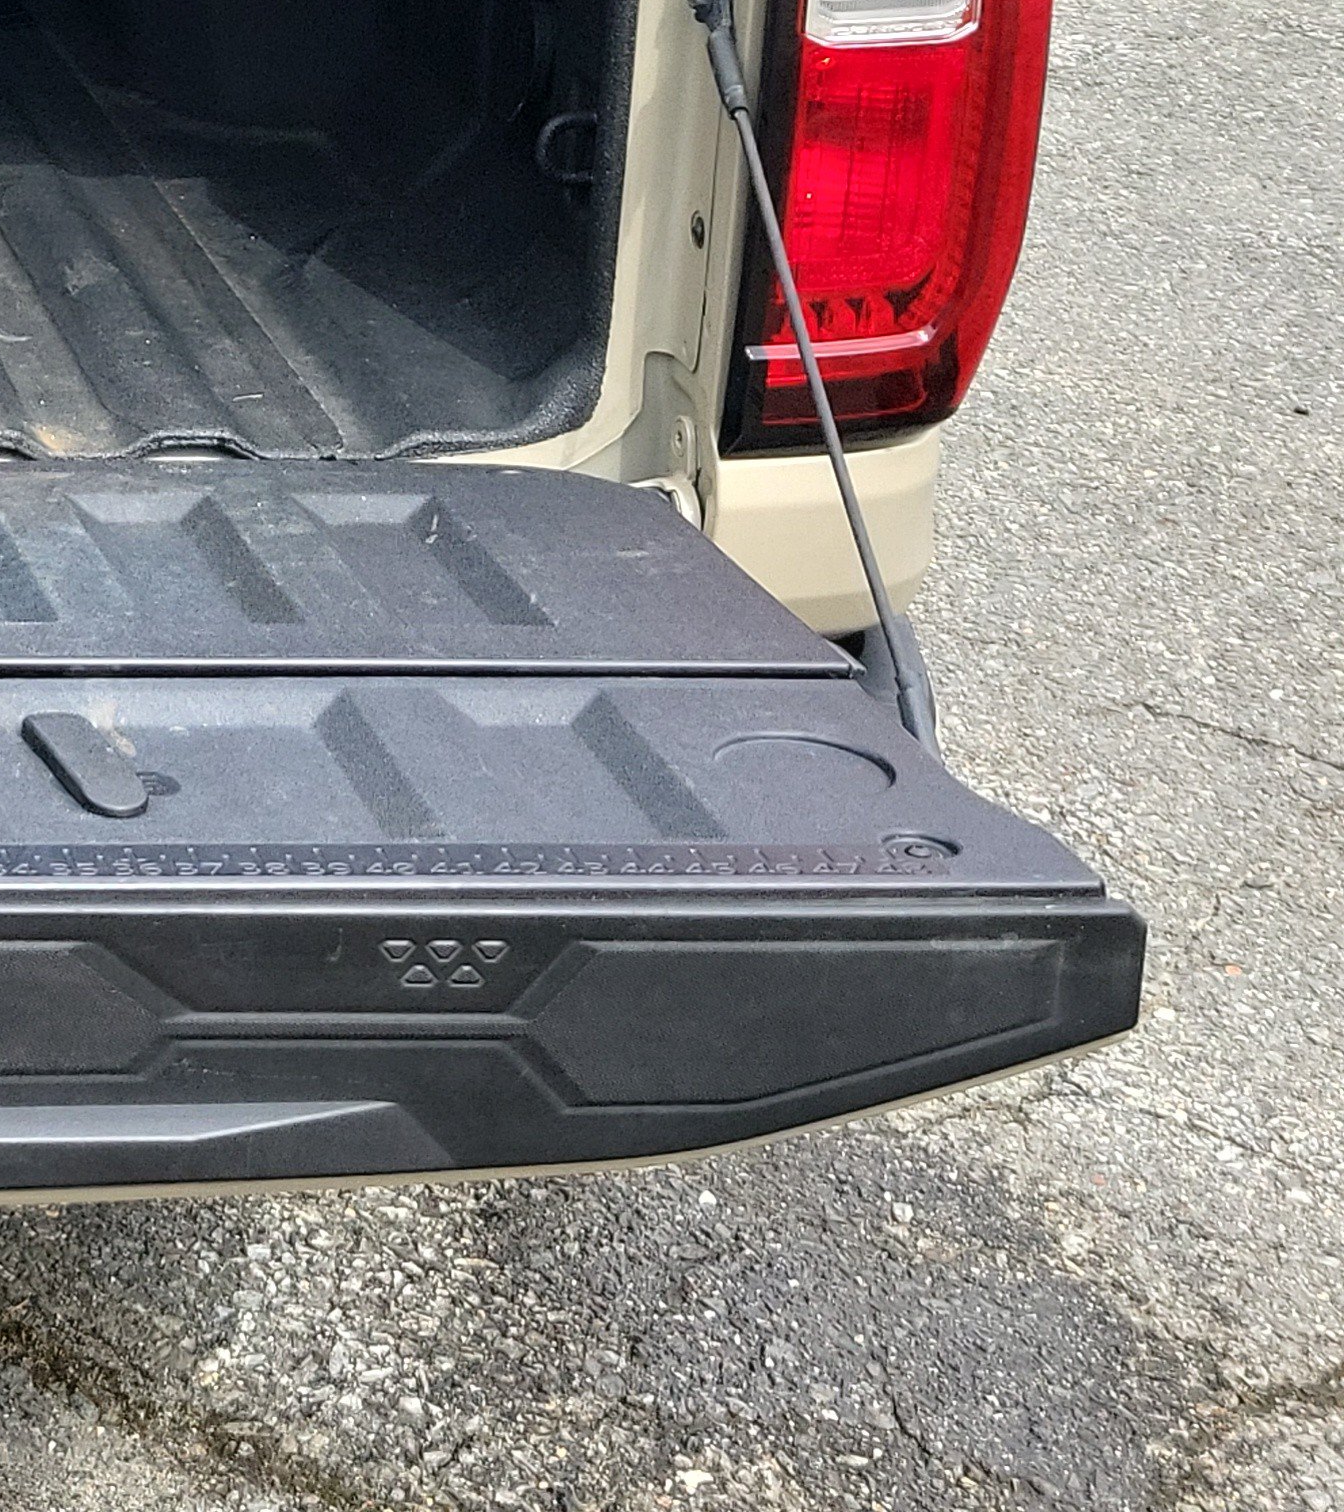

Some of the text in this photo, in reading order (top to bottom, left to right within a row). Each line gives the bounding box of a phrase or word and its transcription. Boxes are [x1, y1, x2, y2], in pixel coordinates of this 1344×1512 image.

[49, 862, 98, 876] 35
[112, 861, 162, 876] 36
[176, 862, 223, 875] 37
[239, 862, 289, 875] 38
[301, 862, 351, 875] 39
[366, 862, 417, 875] 40
[431, 861, 484, 875] 41
[493, 861, 547, 875] 42
[558, 861, 609, 875] 43
[620, 861, 674, 875] 44
[685, 861, 736, 875] 45
[749, 861, 802, 875] 46
[813, 861, 860, 875] 47
